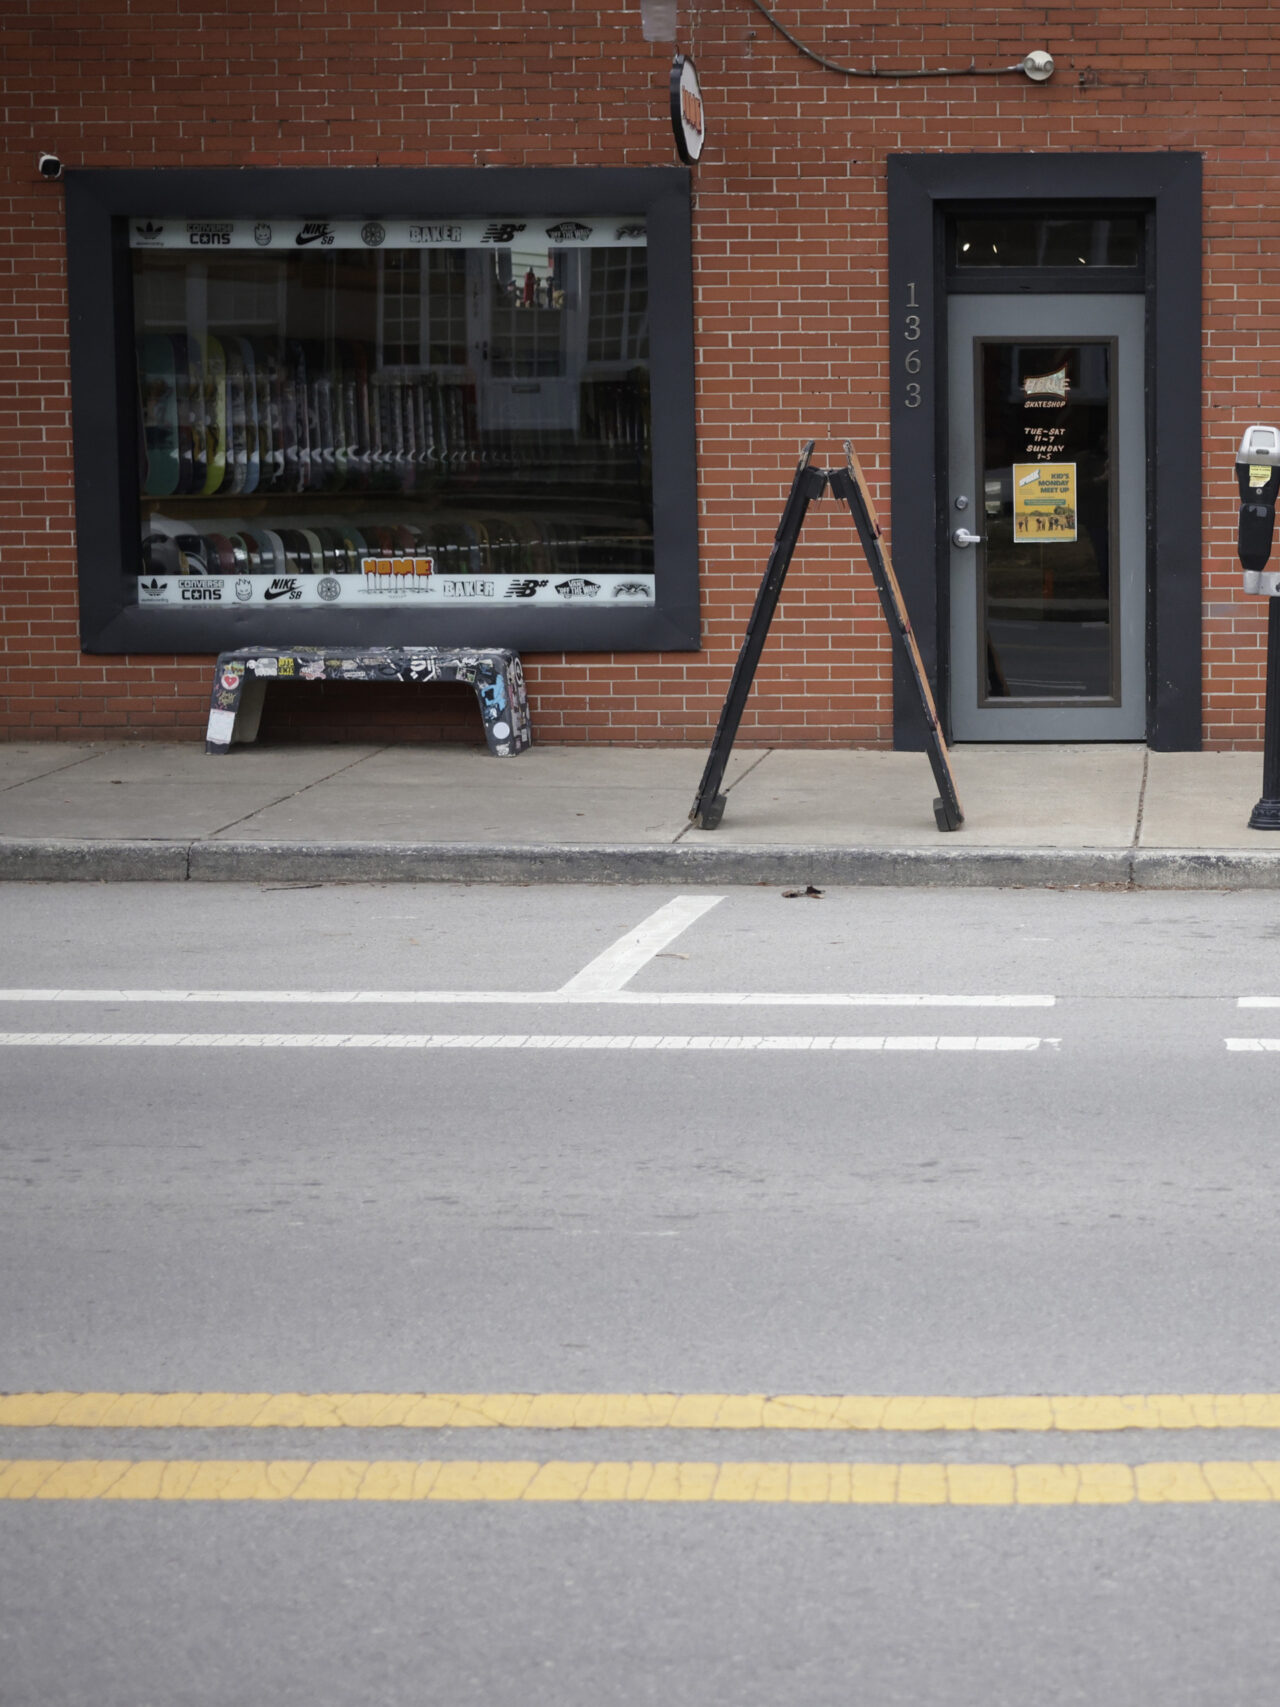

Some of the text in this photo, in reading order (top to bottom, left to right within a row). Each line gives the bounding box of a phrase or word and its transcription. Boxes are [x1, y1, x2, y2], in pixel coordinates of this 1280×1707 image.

[302, 223, 331, 235] NIKE
[409, 225, 462, 243] BAKER
[189, 233, 231, 245] CONS
[320, 235, 334, 245] SB
[904, 282, 921, 408] 1363
[1021, 378, 1071, 391] HOME
[1024, 400, 1066, 409] SKATESHOP
[1024, 427, 1066, 436] TUE-SAT
[1026, 444, 1065, 452] SUNDAY
[364, 559, 433, 576] HOME
[179, 580, 224, 588] CONVERSE
[271, 578, 298, 589] NIKE
[443, 580, 495, 597] BAKER
[182, 589, 222, 600] CONS
[289, 591, 302, 600] SB
